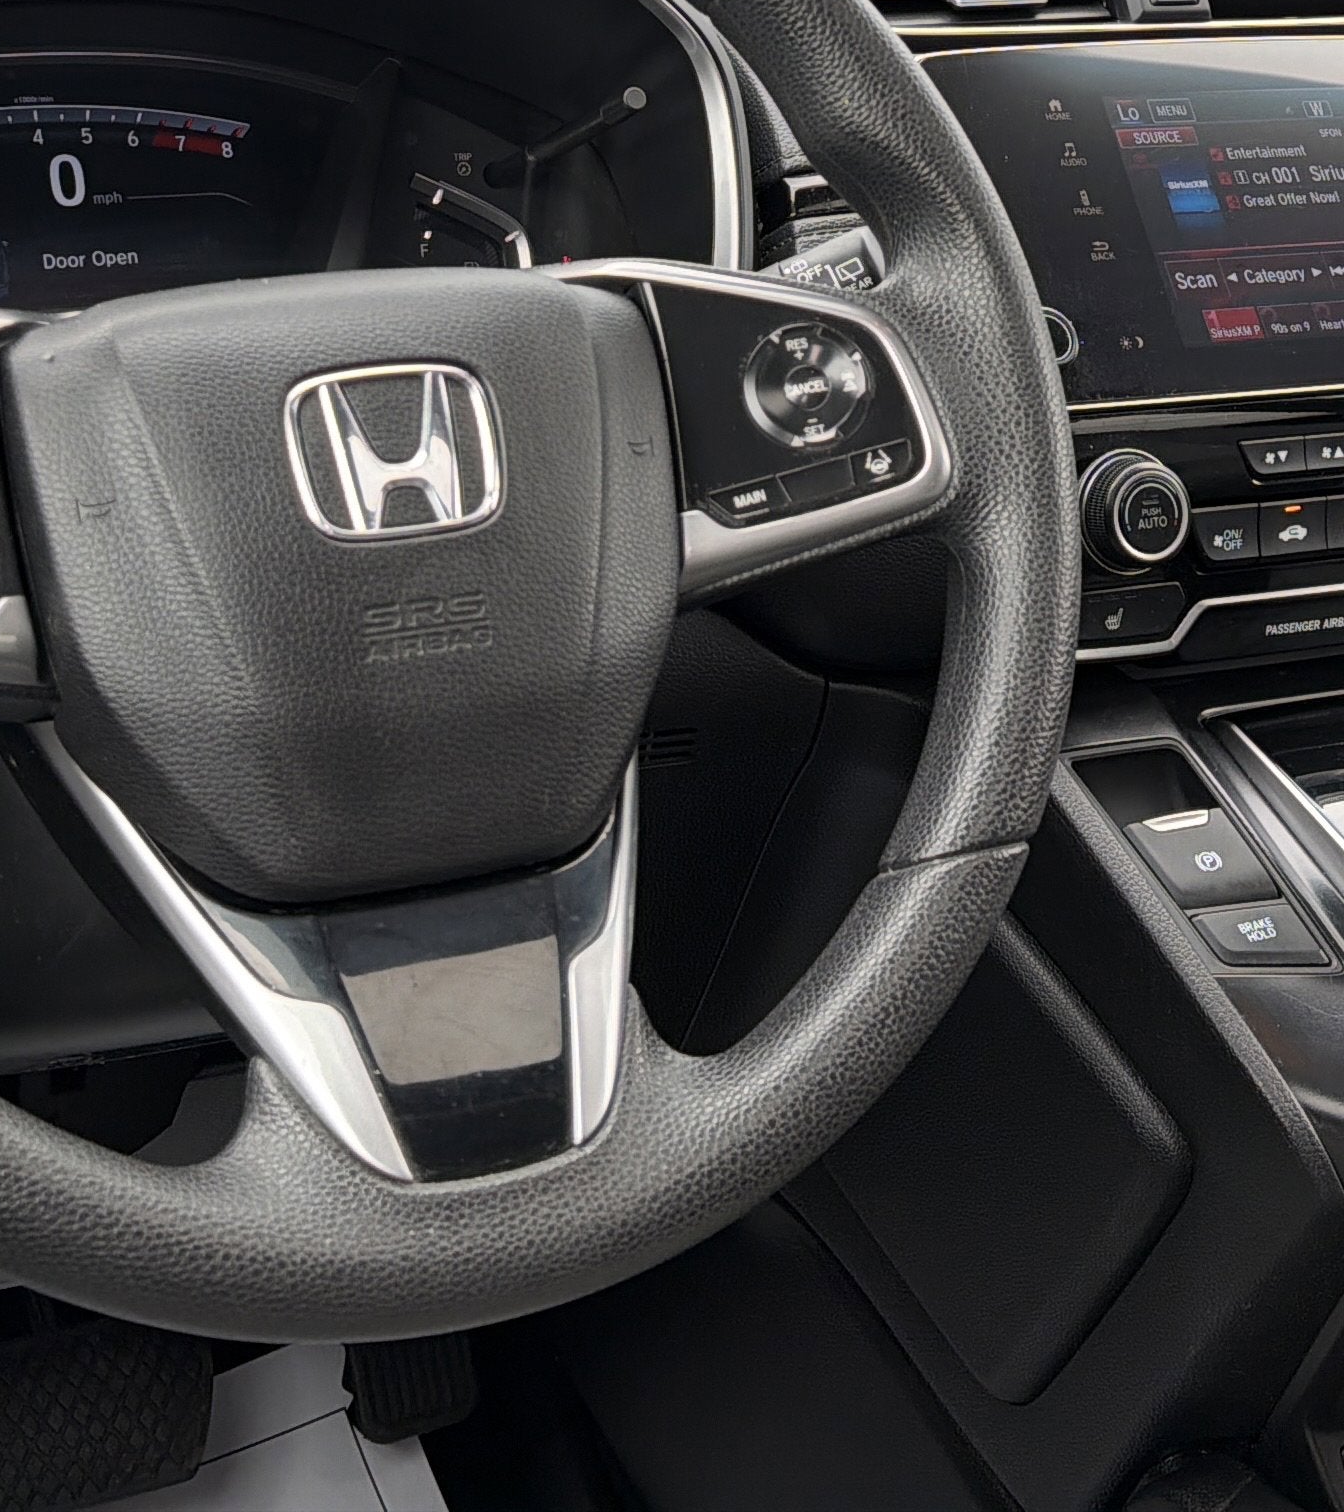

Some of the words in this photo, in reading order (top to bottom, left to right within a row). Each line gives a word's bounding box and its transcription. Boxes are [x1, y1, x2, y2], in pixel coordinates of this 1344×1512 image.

[1045, 112, 1072, 121] HOME
[1117, 103, 1140, 121] Lo
[1156, 104, 1188, 117] MENU
[1309, 102, 1324, 116] W
[32, 127, 44, 146] 4
[81, 126, 93, 146] 5
[128, 129, 140, 148] 6
[175, 134, 186, 152] 7
[221, 140, 234, 159] 8
[1133, 131, 1182, 145] SOURCE
[454, 152, 472, 161] TRIP
[1226, 144, 1307, 160] Entertainment
[1060, 157, 1088, 167] AUDIO
[49, 153, 87, 207] 0
[93, 190, 123, 208] mph
[1252, 172, 1271, 185] CH
[1271, 166, 1301, 184] 001
[1243, 194, 1275, 208] Great
[1278, 192, 1307, 206] Offer
[1310, 190, 1340, 204] Now!
[1073, 206, 1104, 216] PHONE
[420, 243, 429, 258] F
[1091, 251, 1116, 262] BACK
[42, 251, 86, 271] Door
[92, 248, 139, 272] Open
[797, 264, 823, 283] OFF
[1175, 272, 1218, 290] Scan
[1244, 267, 1305, 284] Category
[1211, 325, 1253, 339] SiriusXM
[785, 338, 808, 352] RES
[733, 487, 767, 508] MAIN
[1141, 507, 1162, 516] PUSH
[1138, 516, 1168, 530] AUTO
[1224, 528, 1243, 540] ON/
[1224, 539, 1243, 551] OFF
[363, 591, 485, 634] SRS
[1265, 619, 1321, 637] PASSENGER
[367, 625, 493, 663] AIRBAG
[1237, 916, 1275, 934] BRAKE
[1246, 928, 1277, 943] HOLD
